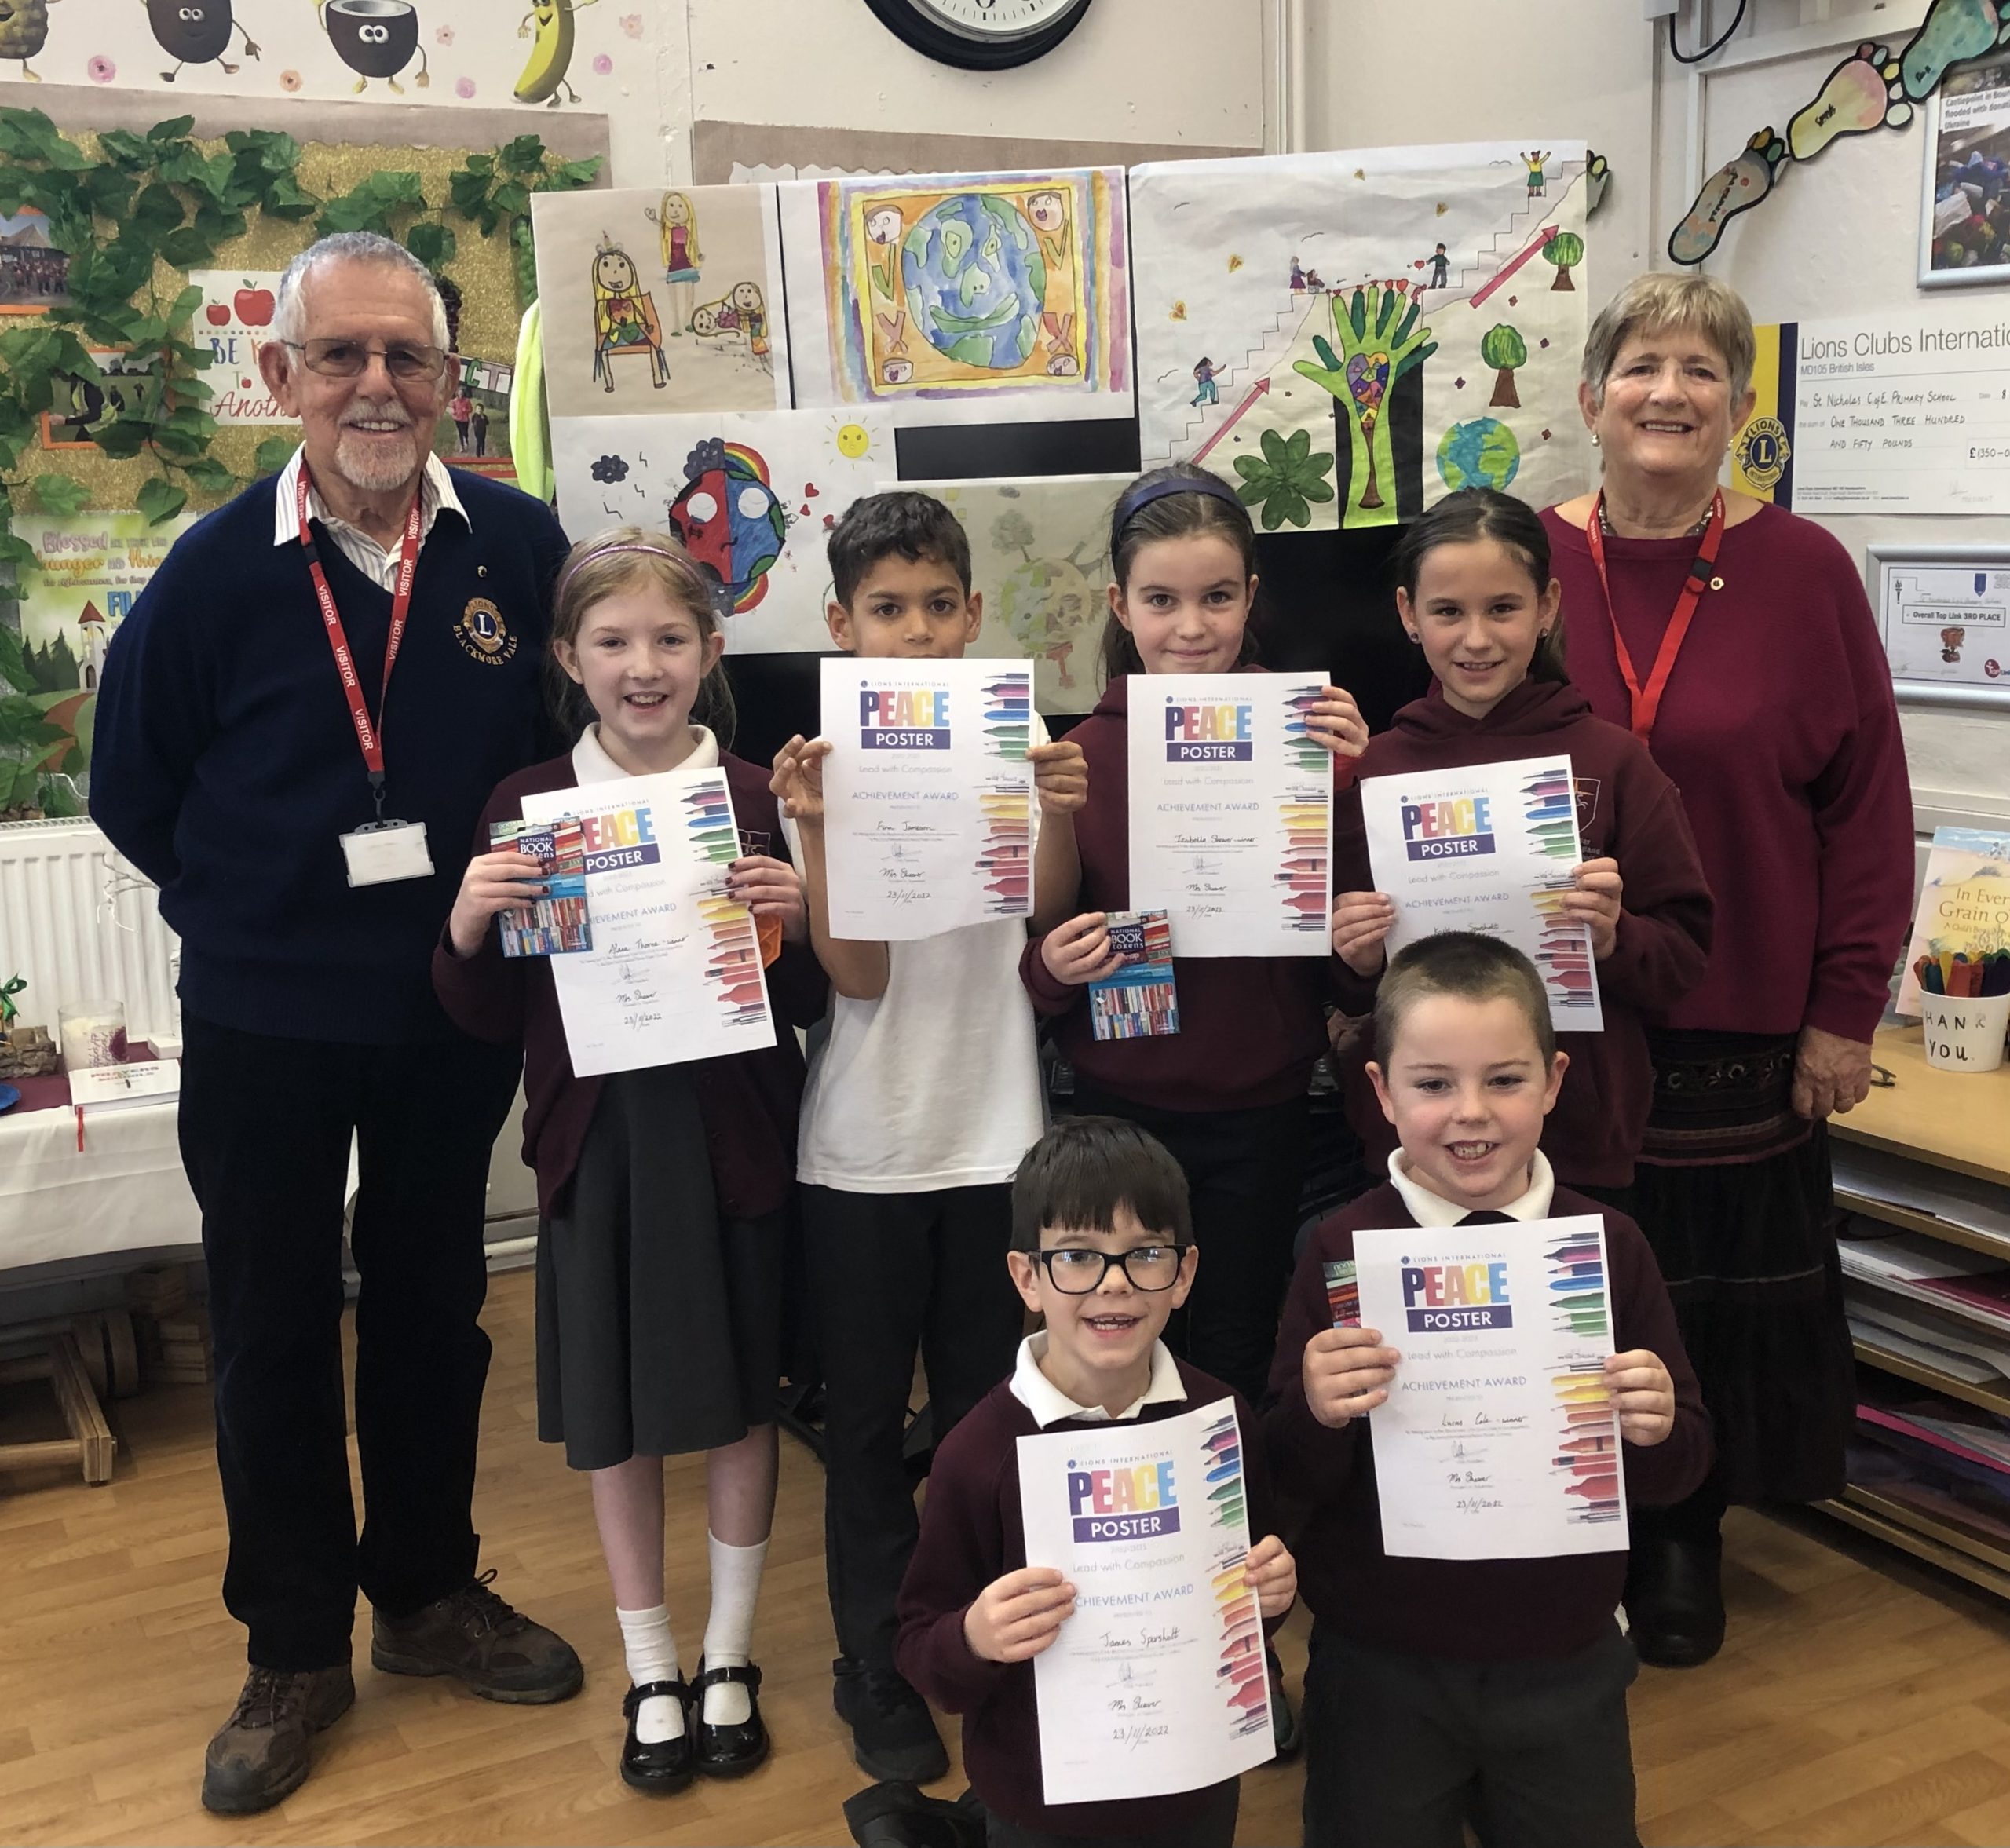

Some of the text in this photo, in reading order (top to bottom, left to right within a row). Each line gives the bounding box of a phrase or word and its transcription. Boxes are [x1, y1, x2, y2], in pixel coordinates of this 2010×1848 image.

[209, 338, 240, 365] BE
[1801, 338, 1847, 360] Lions
[1854, 331, 1912, 356] Clubs
[1800, 362, 1874, 375] MD105 British Isles
[210, 391, 287, 418] Anoth
[1813, 393, 1822, 407] St
[1750, 420, 1780, 435] LIONS
[1891, 415, 1916, 425] THREE
[1924, 414, 1966, 425] HUNDRED
[1759, 440, 1772, 463] L
[1882, 439, 1913, 448] POUNDS
[298, 480, 306, 520] VISITOR
[407, 508, 419, 539] VISITOR
[43, 531, 108, 553] Blessed
[399, 559, 413, 597] VISITOR
[319, 584, 337, 626] VISITOR
[478, 614, 492, 636] L
[389, 619, 404, 659] VISITOR
[452, 625, 504, 665] BLACKMORE
[503, 635, 518, 659] VALE
[336, 645, 356, 688] VISITOR
[860, 690, 950, 727] PEACE
[355, 708, 374, 750] VISITOR
[1165, 705, 1252, 740] PEACE
[875, 732, 934, 747] POSTER
[1181, 747, 1236, 760] POSTER
[901, 765, 952, 775] Compassion
[852, 791, 959, 801] ACHIEVEMENT AWARD
[1157, 802, 1259, 813] ACHIEVEMENT AWARD
[1401, 797, 1492, 840] PEACE
[583, 807, 656, 853] EACE
[520, 842, 554, 854] BOOK
[1421, 839, 1478, 856] POSTER
[586, 850, 644, 873] POSTER
[1449, 869, 1500, 882] Compassion
[1405, 892, 1510, 908] ACHIEVEMENT AWARD
[1957, 887, 1970, 900] In
[641, 902, 677, 918] AWARD
[1939, 900, 1989, 922] Grain
[1112, 933, 1143, 944] BOOK
[1401, 1262, 1510, 1307] PEACE
[1424, 1311, 1493, 1328] POSTER
[1434, 1350, 1453, 1359] with
[1456, 1348, 1517, 1358] Compassion
[1402, 1375, 1527, 1392] ACHIEVEMENT AWARD
[1110, 1450, 1173, 1464] INTERNATIONAL
[1067, 1460, 1178, 1516] PEACE
[1091, 1517, 1162, 1538] POSTER
[1100, 1561, 1120, 1572] with
[1124, 1553, 1185, 1571] Compassion
[1075, 1583, 1194, 1608] CHIEVEMENT AWARD
[1099, 1631, 1131, 1647] James
